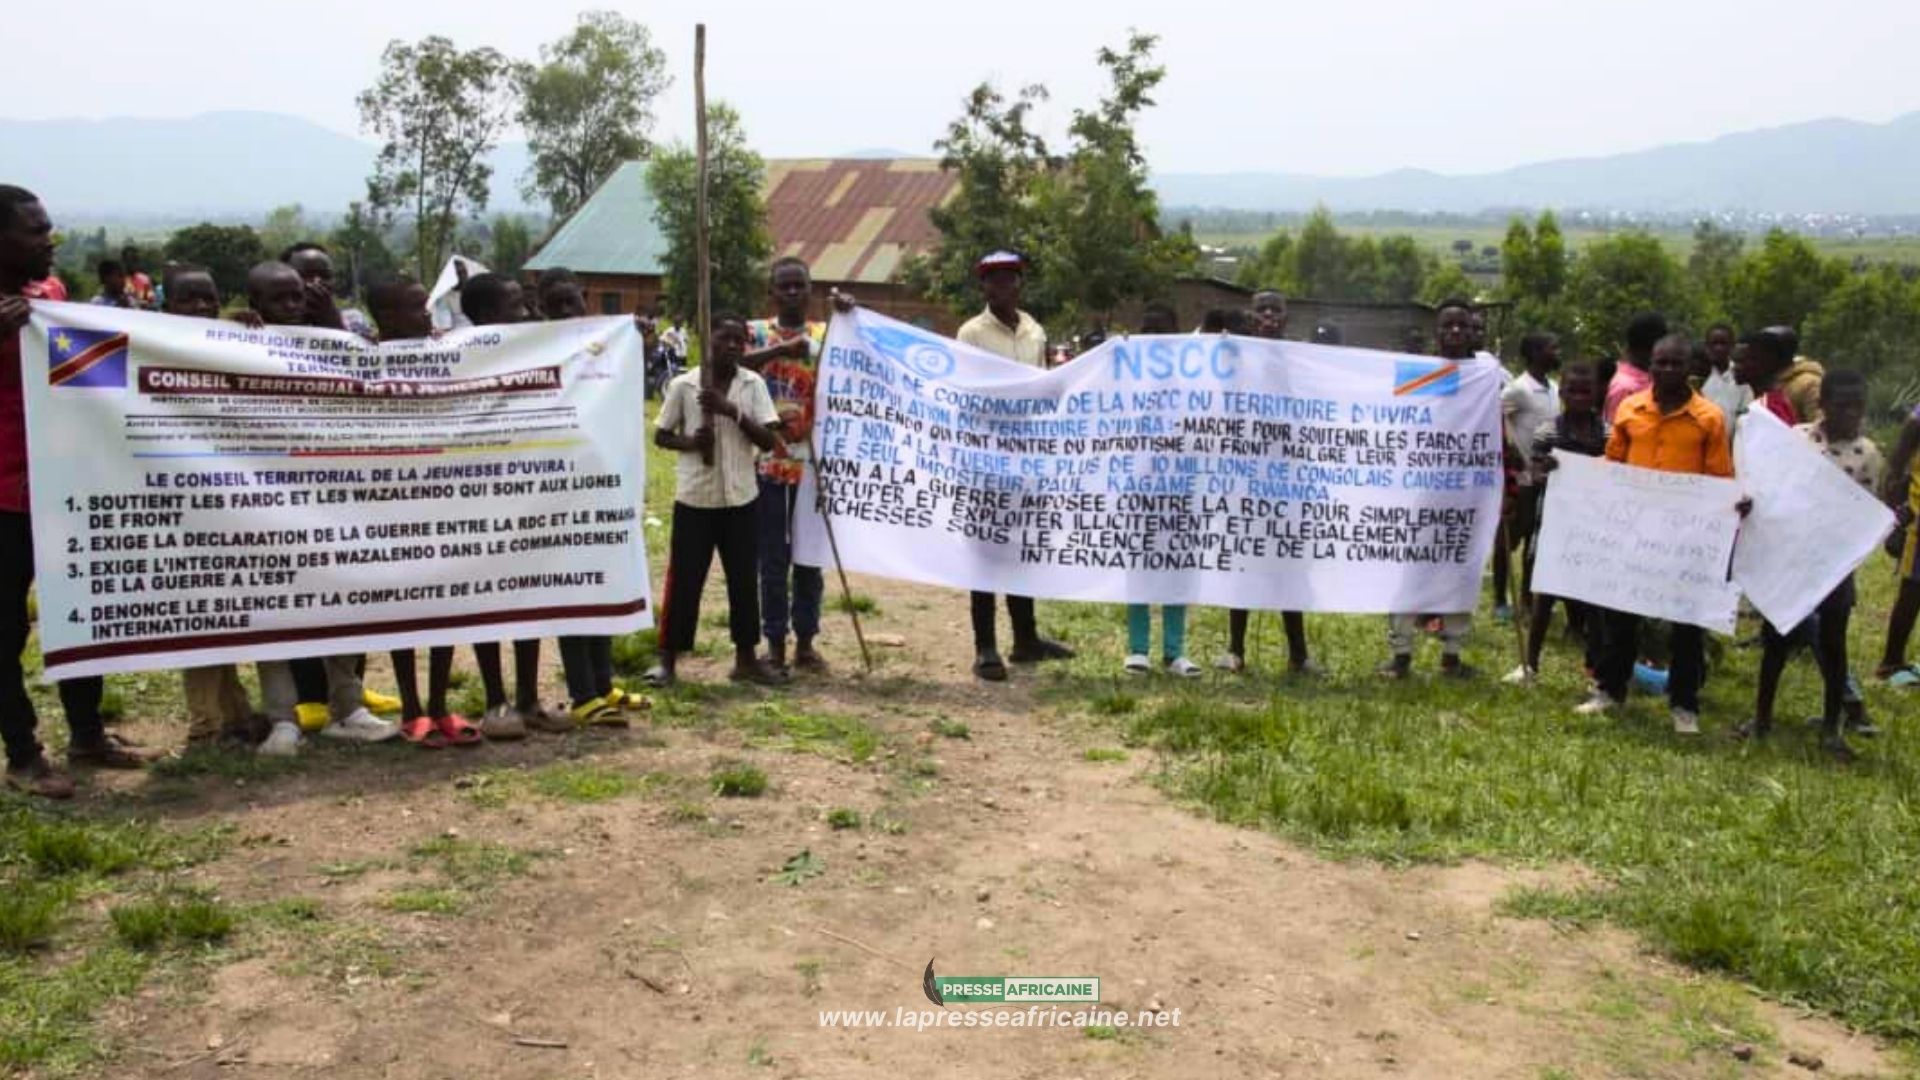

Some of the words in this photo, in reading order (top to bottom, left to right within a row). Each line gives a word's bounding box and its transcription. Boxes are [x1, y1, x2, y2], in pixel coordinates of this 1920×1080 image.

[206, 329, 304, 350] REPUBLIQUE
[357, 355, 380, 367] DU
[1112, 340, 1240, 381] NSCC
[148, 371, 231, 388] CONSEIL
[237, 376, 357, 394] TERRITORIAL
[391, 382, 412, 395] LA
[387, 366, 451, 379] D'UVIRA
[829, 346, 896, 386] BUREAU
[902, 373, 925, 396] DE
[934, 387, 1058, 416] COORDINATION
[1067, 392, 1093, 414] DE
[1100, 392, 1124, 413] LA
[1133, 389, 1181, 411] NSCC
[1188, 391, 1212, 412] DU
[1222, 391, 1338, 423] TERRITOIRE
[1351, 402, 1433, 425] D'UVIRA
[826, 395, 923, 433] WAZALENDO
[929, 424, 952, 443] QUI
[956, 430, 990, 449] FONT
[997, 436, 1057, 456] MONTRE
[1063, 439, 1086, 455] DU
[1091, 435, 1185, 453] PATRIOTISME
[1193, 436, 1214, 453] AU
[1221, 437, 1270, 457] FRONT
[1282, 442, 1346, 464] MALGRE
[1357, 448, 1397, 467] LEUR
[828, 374, 852, 395] LA
[957, 410, 977, 432] DU
[987, 416, 1089, 439] TERRITOIRE
[1253, 421, 1291, 442] POUR
[1299, 425, 1369, 449] SOUTENIR
[1375, 430, 1407, 450] LES
[1416, 431, 1467, 451] FARDC
[1471, 432, 1490, 451] ET
[146, 473, 168, 487] LE
[174, 471, 249, 486] CONSEIL
[254, 469, 365, 485] TERRITORIAL
[371, 469, 393, 482] DE
[398, 467, 417, 481] LA
[422, 464, 501, 480] JEUNESSE
[507, 459, 566, 475] D'UVIRA
[822, 436, 842, 457] LE
[856, 441, 904, 466] SEUL
[1037, 476, 1085, 493] PAUL
[1107, 474, 1196, 494] KAGAME
[1207, 476, 1235, 494] DU
[862, 421, 895, 442] NON
[901, 433, 912, 448] A
[917, 438, 939, 458] LA
[950, 446, 1011, 473] TUERIE
[1020, 457, 1045, 477] DE
[1056, 456, 1100, 476] PLUS
[1109, 455, 1135, 474] DE
[1151, 455, 1169, 474] 10
[1174, 455, 1258, 477] MILLIONS
[1267, 460, 1289, 481] DE
[1296, 465, 1393, 487] CONGOLAIS
[1402, 469, 1466, 491] CAUSEE
[66, 498, 82, 512] 1.
[88, 494, 186, 511] SOUTIENT
[191, 494, 225, 509] LES
[231, 491, 285, 507] FARDC
[290, 490, 312, 505] ET
[316, 489, 347, 504] LES
[352, 482, 455, 502] WAZALENDO
[460, 483, 487, 498] QUI
[493, 481, 534, 496] SONT
[539, 478, 568, 493] AUX
[572, 474, 622, 491] LIGNES
[818, 476, 905, 505] OCCUPER
[916, 489, 941, 510] ET
[952, 502, 1063, 529] EXPLOITER
[1073, 512, 1215, 533] ILLICITEMENT
[1226, 515, 1252, 536] ET
[1266, 521, 1421, 544] ILLEGALEMENT
[1434, 526, 1472, 546] LES
[819, 456, 861, 479] NON
[868, 463, 883, 482] A
[889, 466, 916, 487] LA
[929, 477, 1012, 511] GUERRE
[1020, 492, 1106, 513] IMPOSEE
[1116, 494, 1193, 514] CONTRE
[1201, 497, 1230, 516] LA
[1240, 498, 1289, 519] RDC
[1301, 500, 1350, 522] POUR
[1360, 505, 1476, 528] SIMPLEMENT
[67, 538, 84, 554] 2.
[90, 534, 149, 552] EXIGE
[154, 533, 177, 549] LA
[183, 529, 308, 548] DECLARATION
[314, 527, 335, 543] DE
[340, 526, 360, 541] LA
[366, 522, 431, 539] GUERRE
[436, 517, 488, 536] ENTRE
[493, 517, 513, 533] LA
[518, 514, 546, 530] RDC
[551, 511, 568, 527] ET
[573, 510, 591, 525] LE
[89, 514, 114, 530] DE
[121, 511, 184, 528] FRONT
[814, 494, 933, 529] RICHESSES
[946, 518, 1010, 545] SOUS
[1021, 529, 1052, 549] LE
[1066, 531, 1156, 550] SILENCE
[1168, 533, 1266, 557] COMPLICE
[1277, 540, 1305, 560] DE
[1313, 542, 1336, 560] LA
[1346, 544, 1468, 564] COMMUNAUTE
[67, 563, 84, 579] 3.
[90, 560, 148, 577] EXIGE
[153, 554, 292, 574] L'INTEGRATION
[297, 552, 330, 568] DES
[335, 545, 436, 566] WAZALENDO
[440, 541, 483, 558] DANS
[487, 540, 506, 555] LE
[509, 529, 630, 551] COMMANDEMENT
[68, 609, 85, 624] 4.
[91, 602, 180, 622] DENONCE
[186, 599, 208, 615] LE
[213, 594, 289, 612] SILENCE
[294, 592, 316, 608] ET
[321, 591, 341, 606] LA
[347, 584, 446, 605] COMPLICITE
[450, 582, 470, 597] DE
[474, 580, 494, 595] LA
[497, 571, 605, 591] COMMUNAUTE
[91, 579, 116, 595] DE
[122, 577, 145, 593] LA
[151, 573, 226, 591] GUERRE
[231, 572, 243, 587] A
[249, 570, 298, 586] L'EST
[91, 614, 251, 640] INTERNATIONALE
